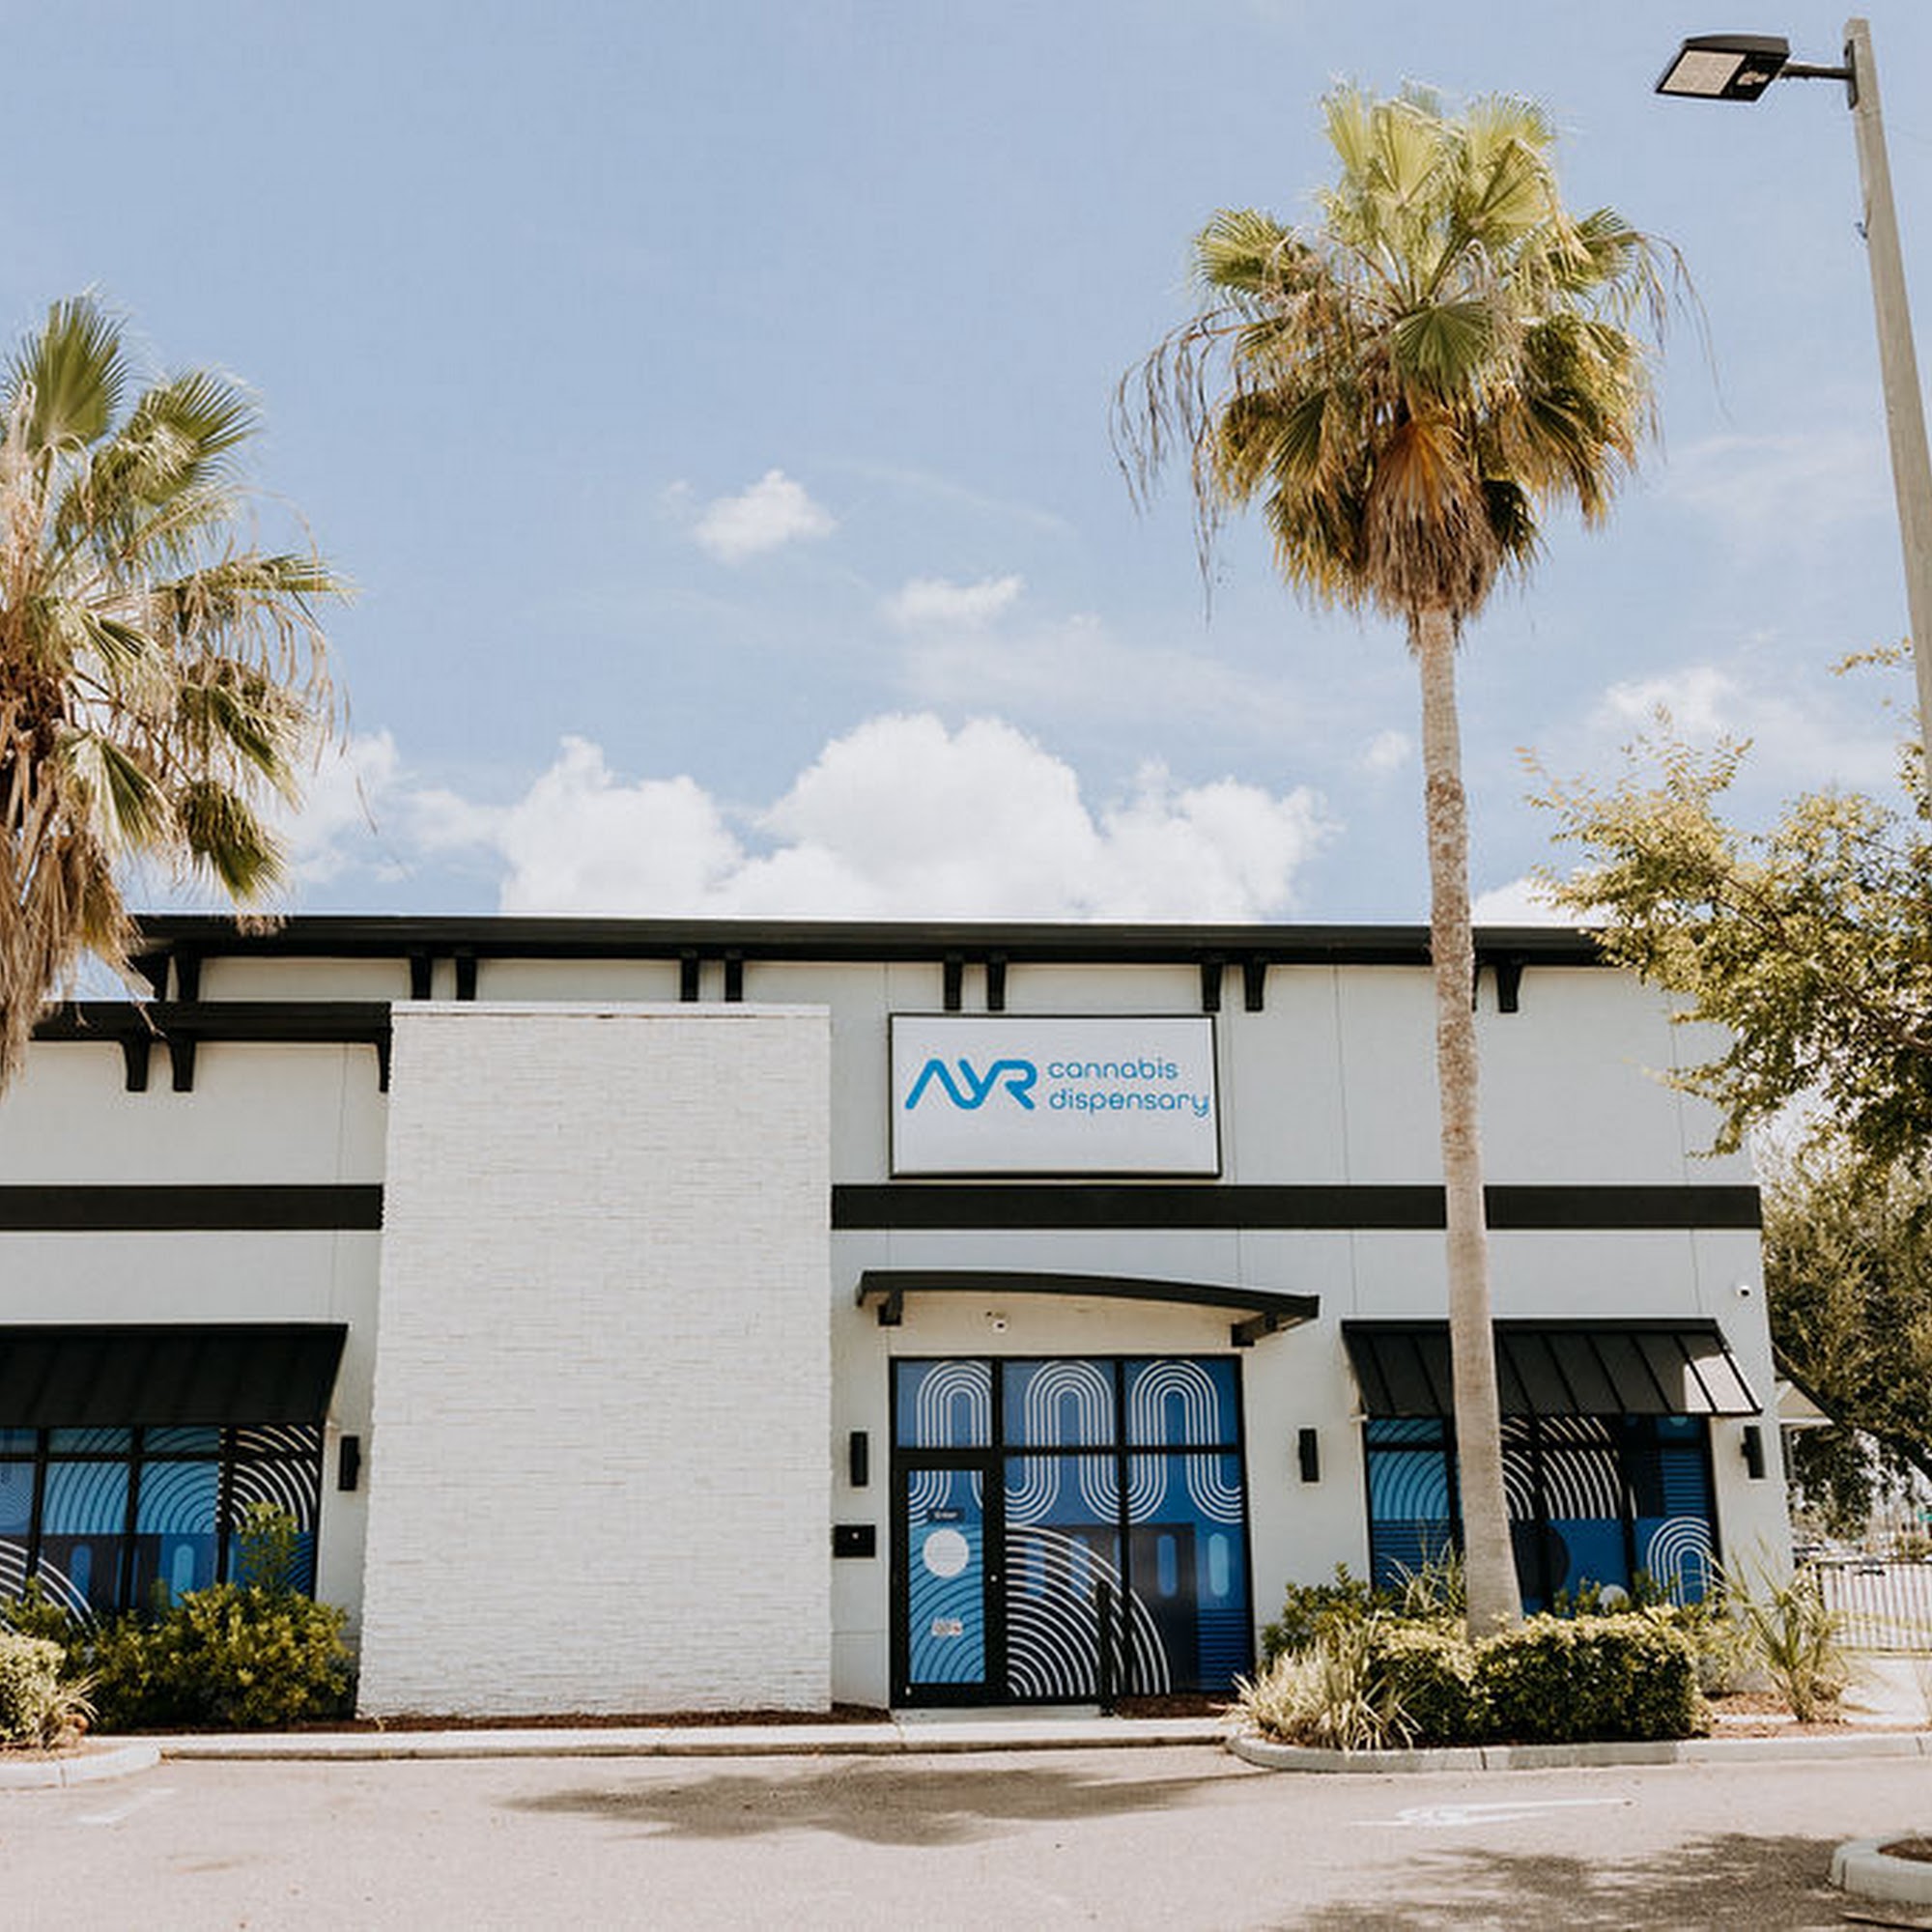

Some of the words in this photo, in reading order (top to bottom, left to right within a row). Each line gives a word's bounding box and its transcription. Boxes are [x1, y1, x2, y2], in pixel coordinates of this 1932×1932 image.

[1048, 1059, 1177, 1080] cannabis
[904, 1058, 1037, 1110] AYR
[1049, 1090, 1210, 1116] dispensary
